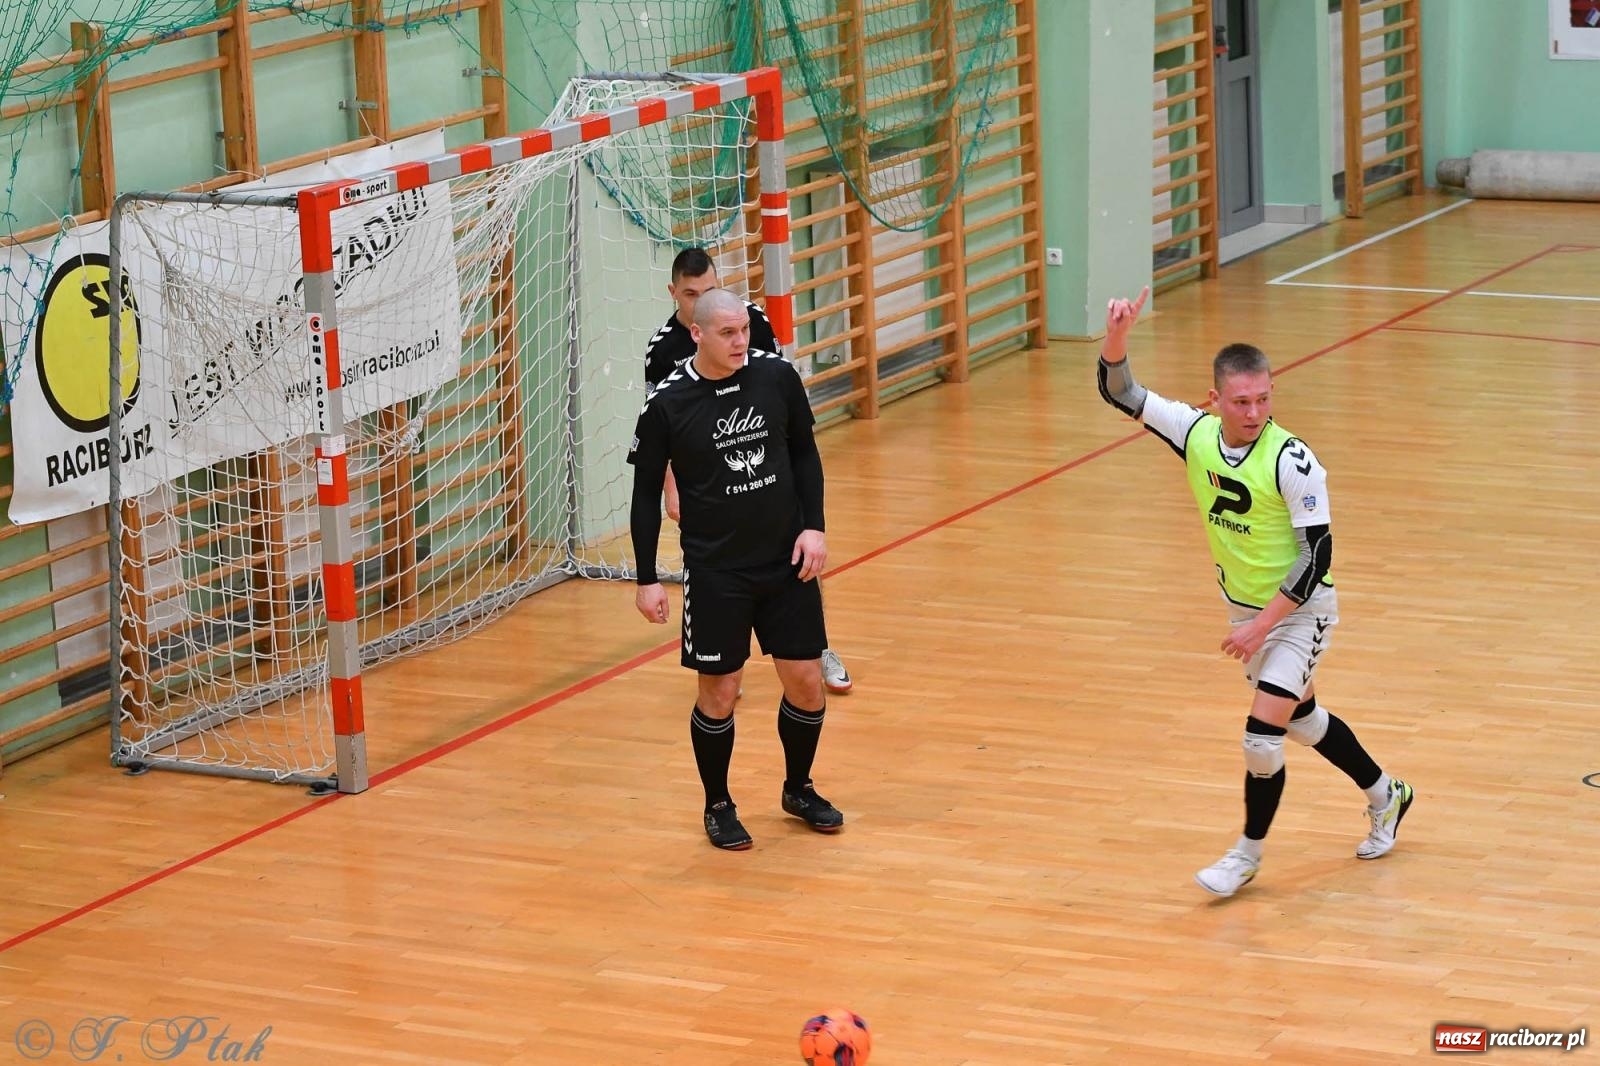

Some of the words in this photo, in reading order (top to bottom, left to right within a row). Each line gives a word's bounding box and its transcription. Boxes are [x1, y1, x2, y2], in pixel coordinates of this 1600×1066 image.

[716, 384, 740, 396] hummel
[712, 406, 766, 440] Ada
[716, 438, 737, 450] SALON
[737, 430, 769, 444] FRYZJERSKI
[733, 484, 748, 494] 514
[749, 480, 763, 491] 260
[764, 474, 777, 486] 902
[1208, 513, 1251, 535] PATRICK
[696, 652, 721, 661] hummel
